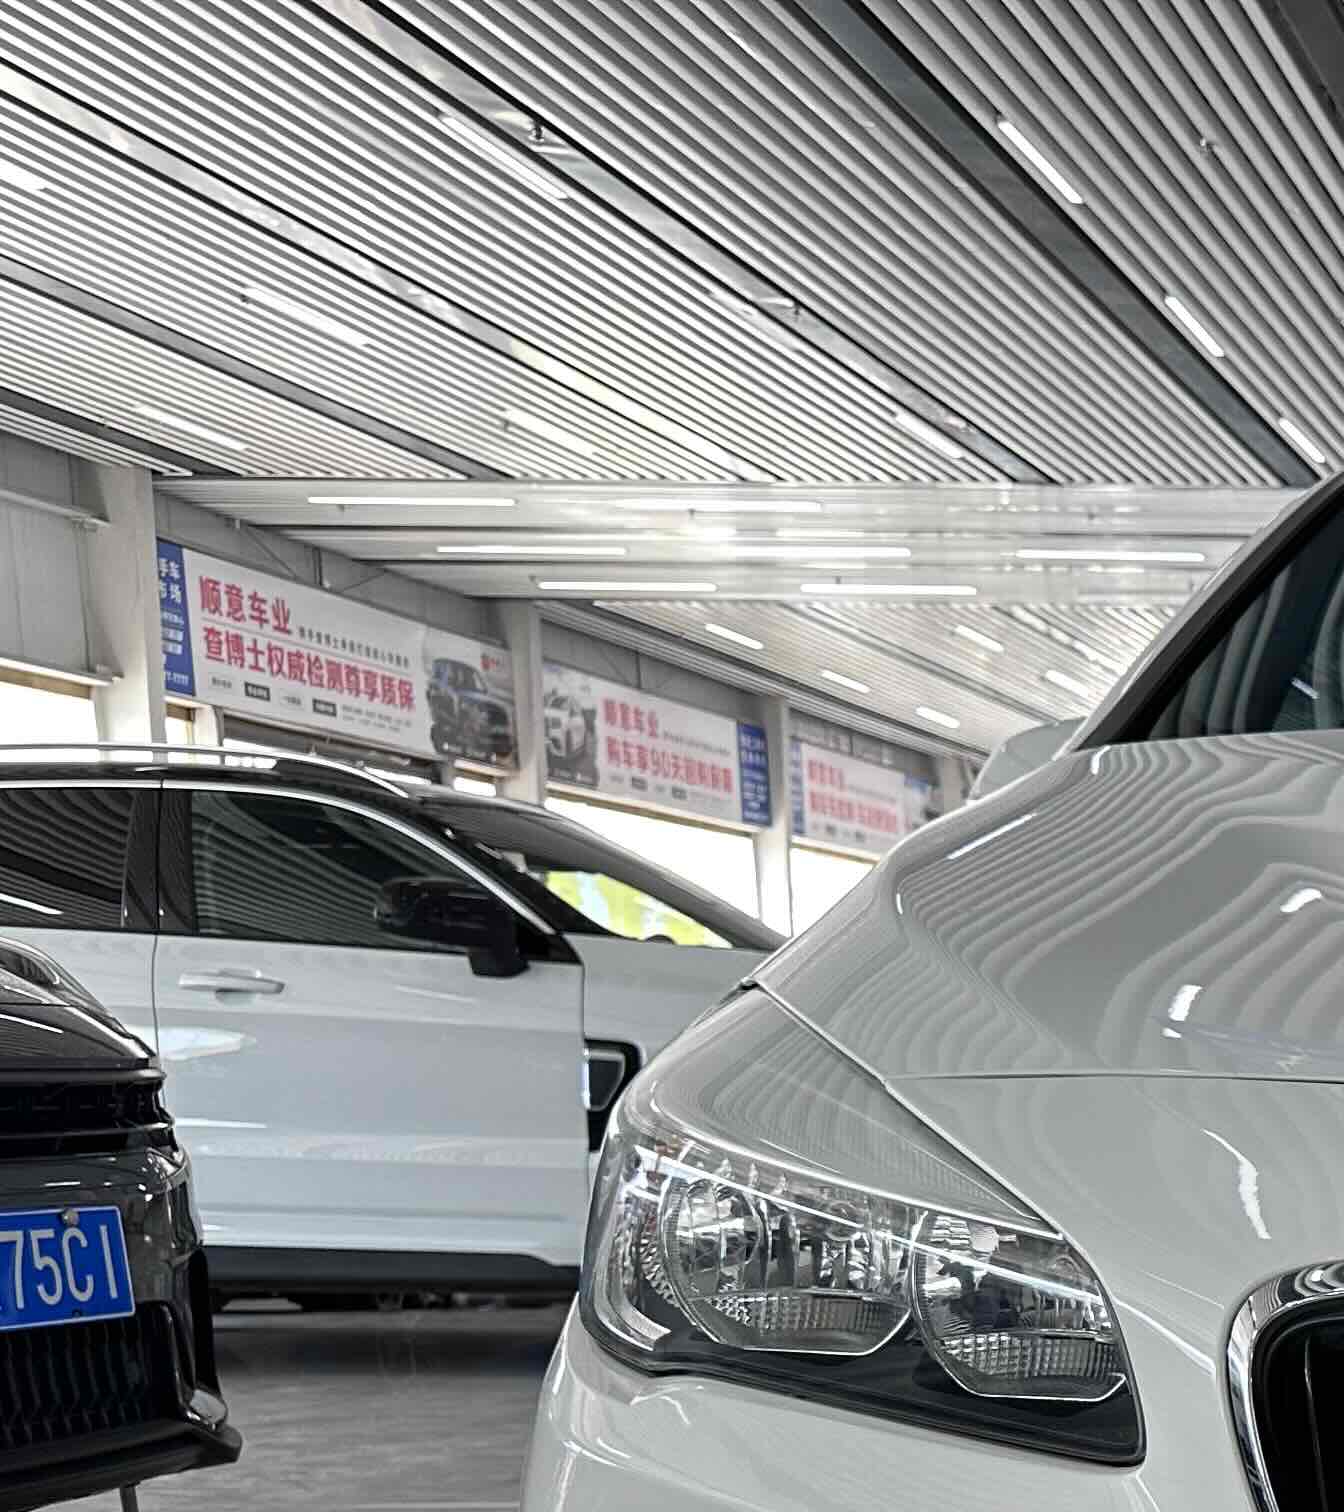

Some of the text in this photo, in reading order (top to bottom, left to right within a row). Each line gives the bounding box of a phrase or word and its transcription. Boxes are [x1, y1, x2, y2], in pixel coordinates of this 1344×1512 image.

[199, 575, 292, 636] 顺意车业
[203, 625, 416, 712] 查博士权威检测尊享质保
